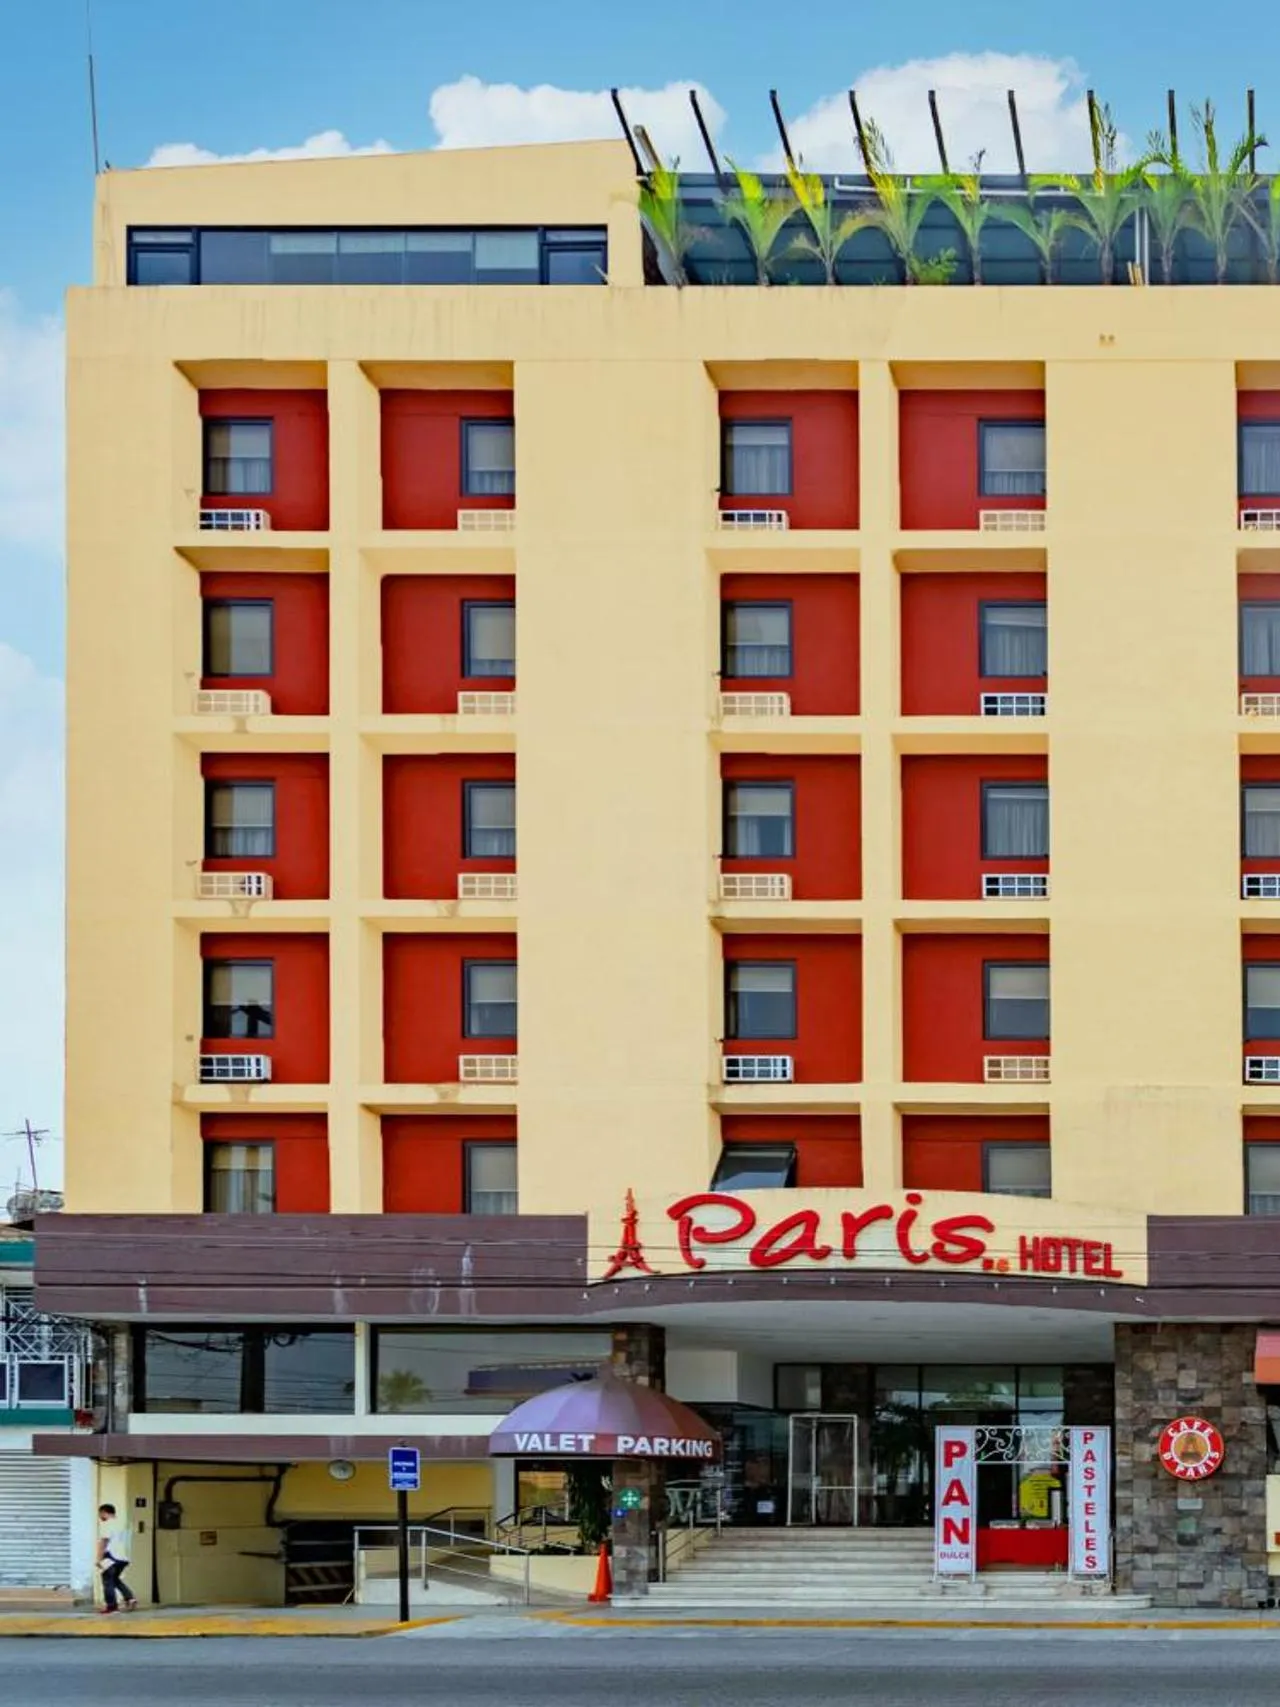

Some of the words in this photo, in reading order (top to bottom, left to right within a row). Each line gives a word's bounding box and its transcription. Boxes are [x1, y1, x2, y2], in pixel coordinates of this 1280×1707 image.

[667, 1193, 995, 1269] Paris
[1019, 1235, 1123, 1278] HOTEL
[514, 1433, 595, 1452] VALET
[616, 1434, 713, 1457] PARKING
[941, 1440, 970, 1545] PAN
[1082, 1431, 1097, 1569] PASTELES
